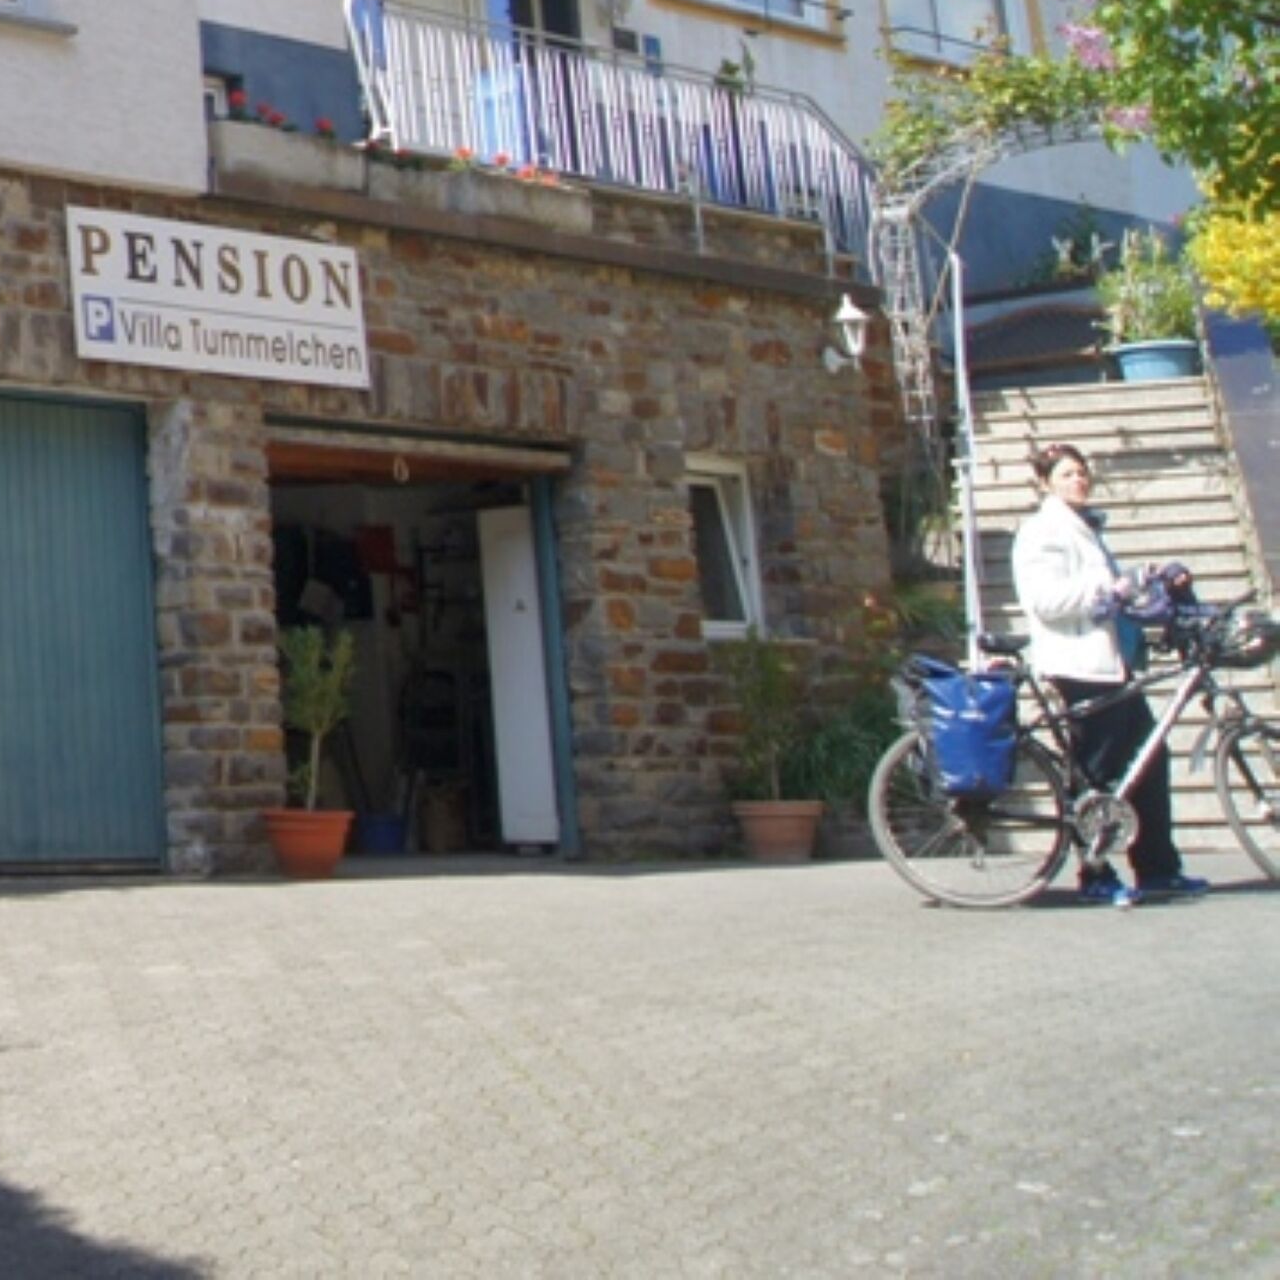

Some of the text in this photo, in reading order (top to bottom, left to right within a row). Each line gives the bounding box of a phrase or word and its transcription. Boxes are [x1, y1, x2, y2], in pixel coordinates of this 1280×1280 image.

[77, 224, 353, 310] PENSION
[83, 296, 363, 372] P Villa Tummelchen
